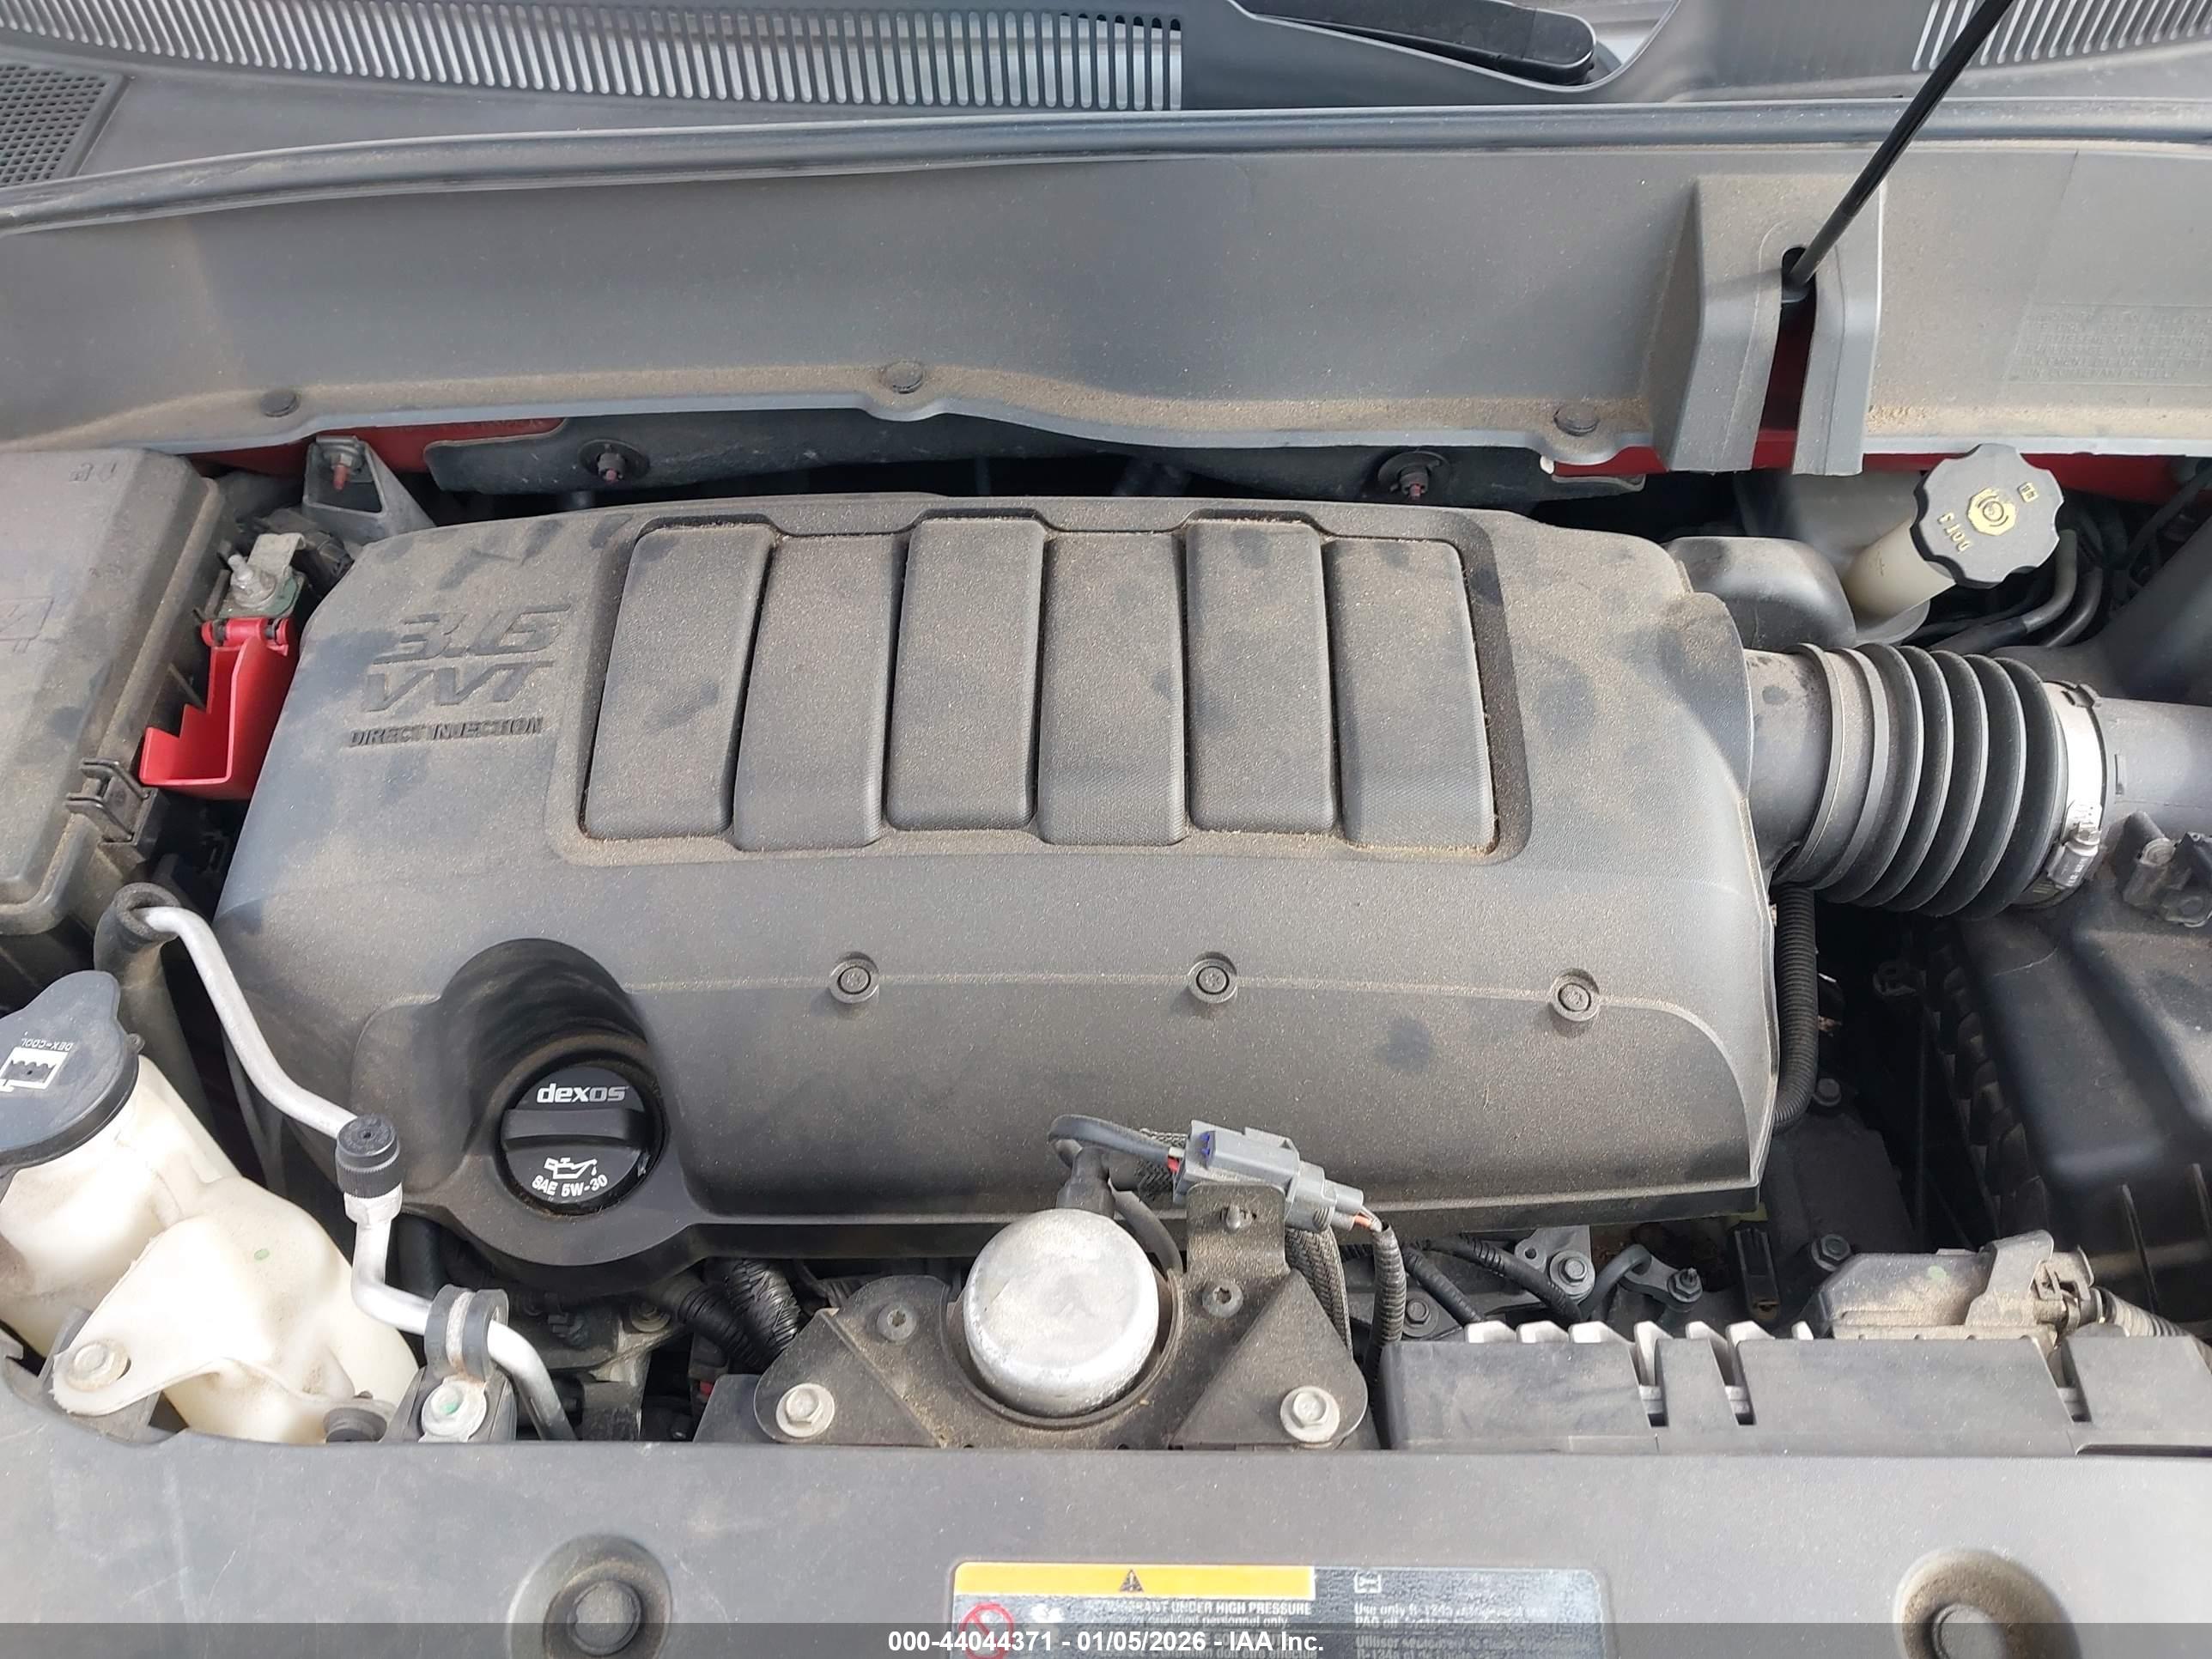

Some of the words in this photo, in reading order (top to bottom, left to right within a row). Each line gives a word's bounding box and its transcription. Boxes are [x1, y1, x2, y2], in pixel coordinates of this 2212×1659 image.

[372, 603, 573, 665] 3.6
[362, 659, 555, 713] VVT
[348, 725, 427, 748] DIRECT
[432, 716, 544, 742] INJECTION
[536, 1082, 628, 1104] dexos
[532, 1174, 558, 1197] SAE
[561, 1173, 608, 1197] 5W-30
[1170, 1601, 1212, 1614] UNDER
[1216, 1601, 1246, 1615] HIGH
[1248, 1601, 1312, 1616] PRESSURE
[1353, 1601, 1376, 1616] Use
[1201, 1615, 1260, 1629] personnel
